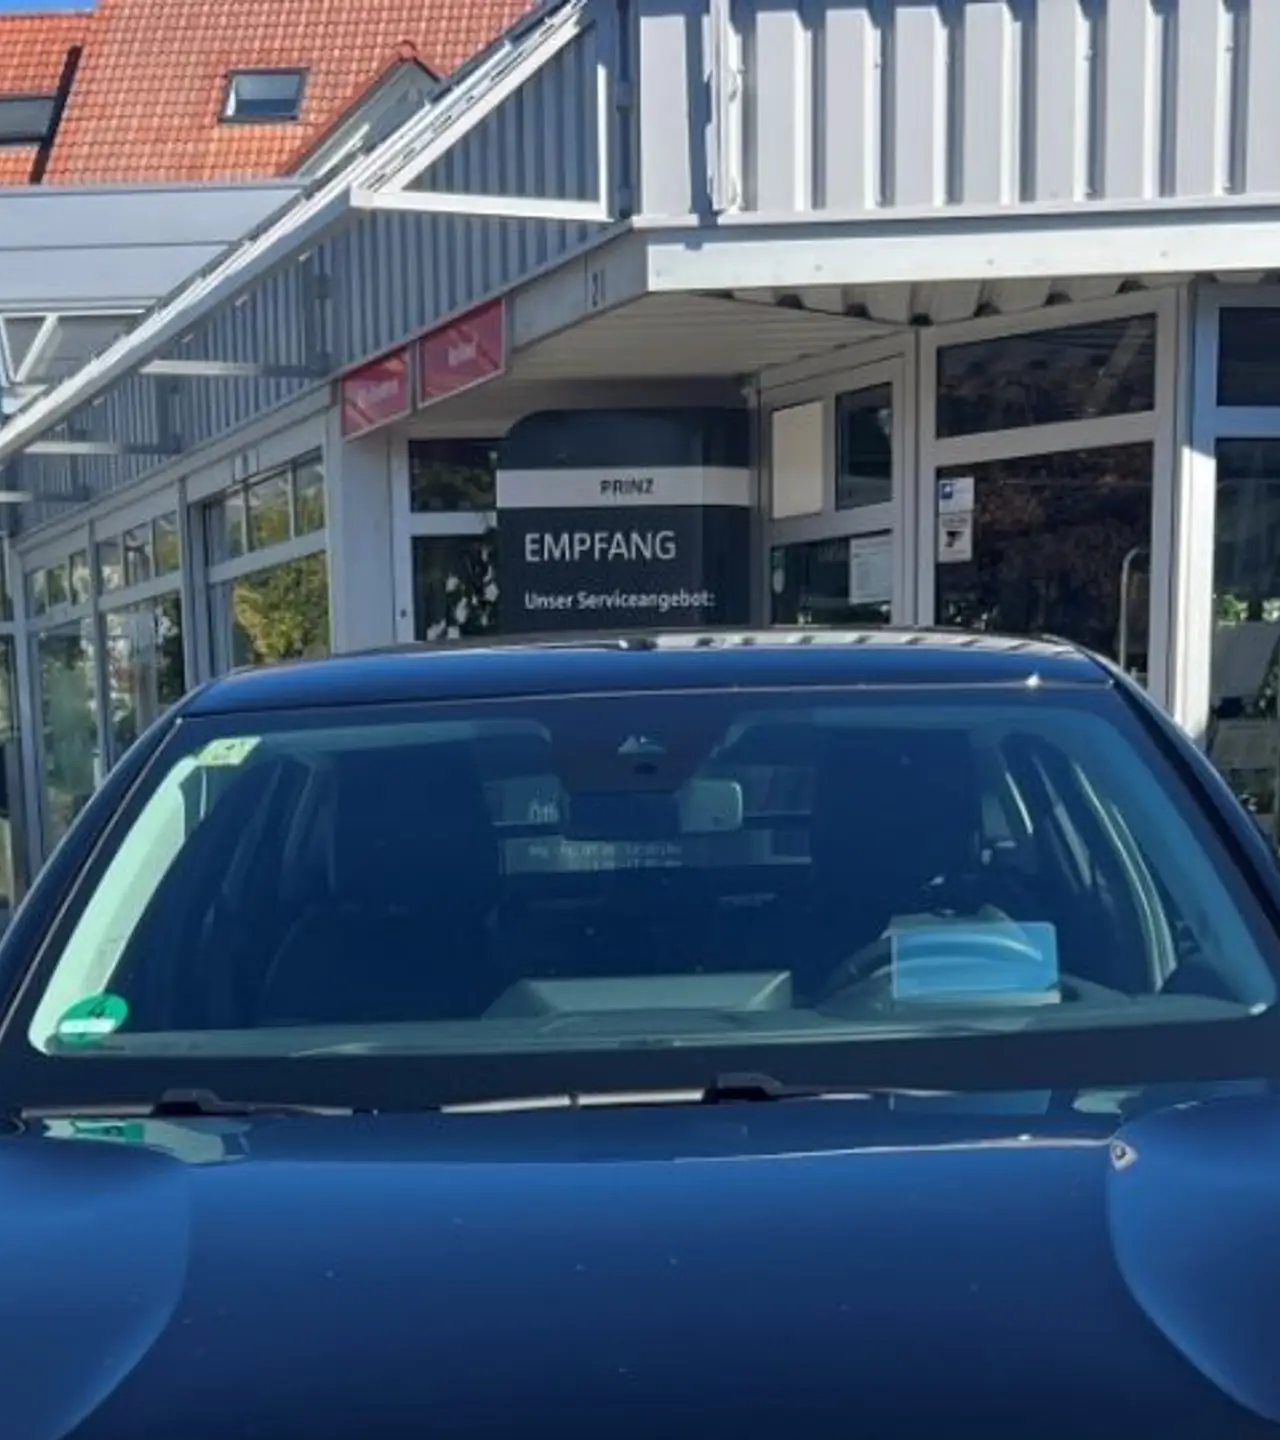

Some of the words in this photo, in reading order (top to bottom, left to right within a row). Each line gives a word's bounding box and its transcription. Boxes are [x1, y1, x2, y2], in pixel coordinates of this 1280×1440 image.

[600, 478, 654, 495] PRINZ
[524, 531, 677, 562] EMPFANG
[524, 591, 573, 609] Unser
[577, 588, 716, 612] Serviceangebot:
